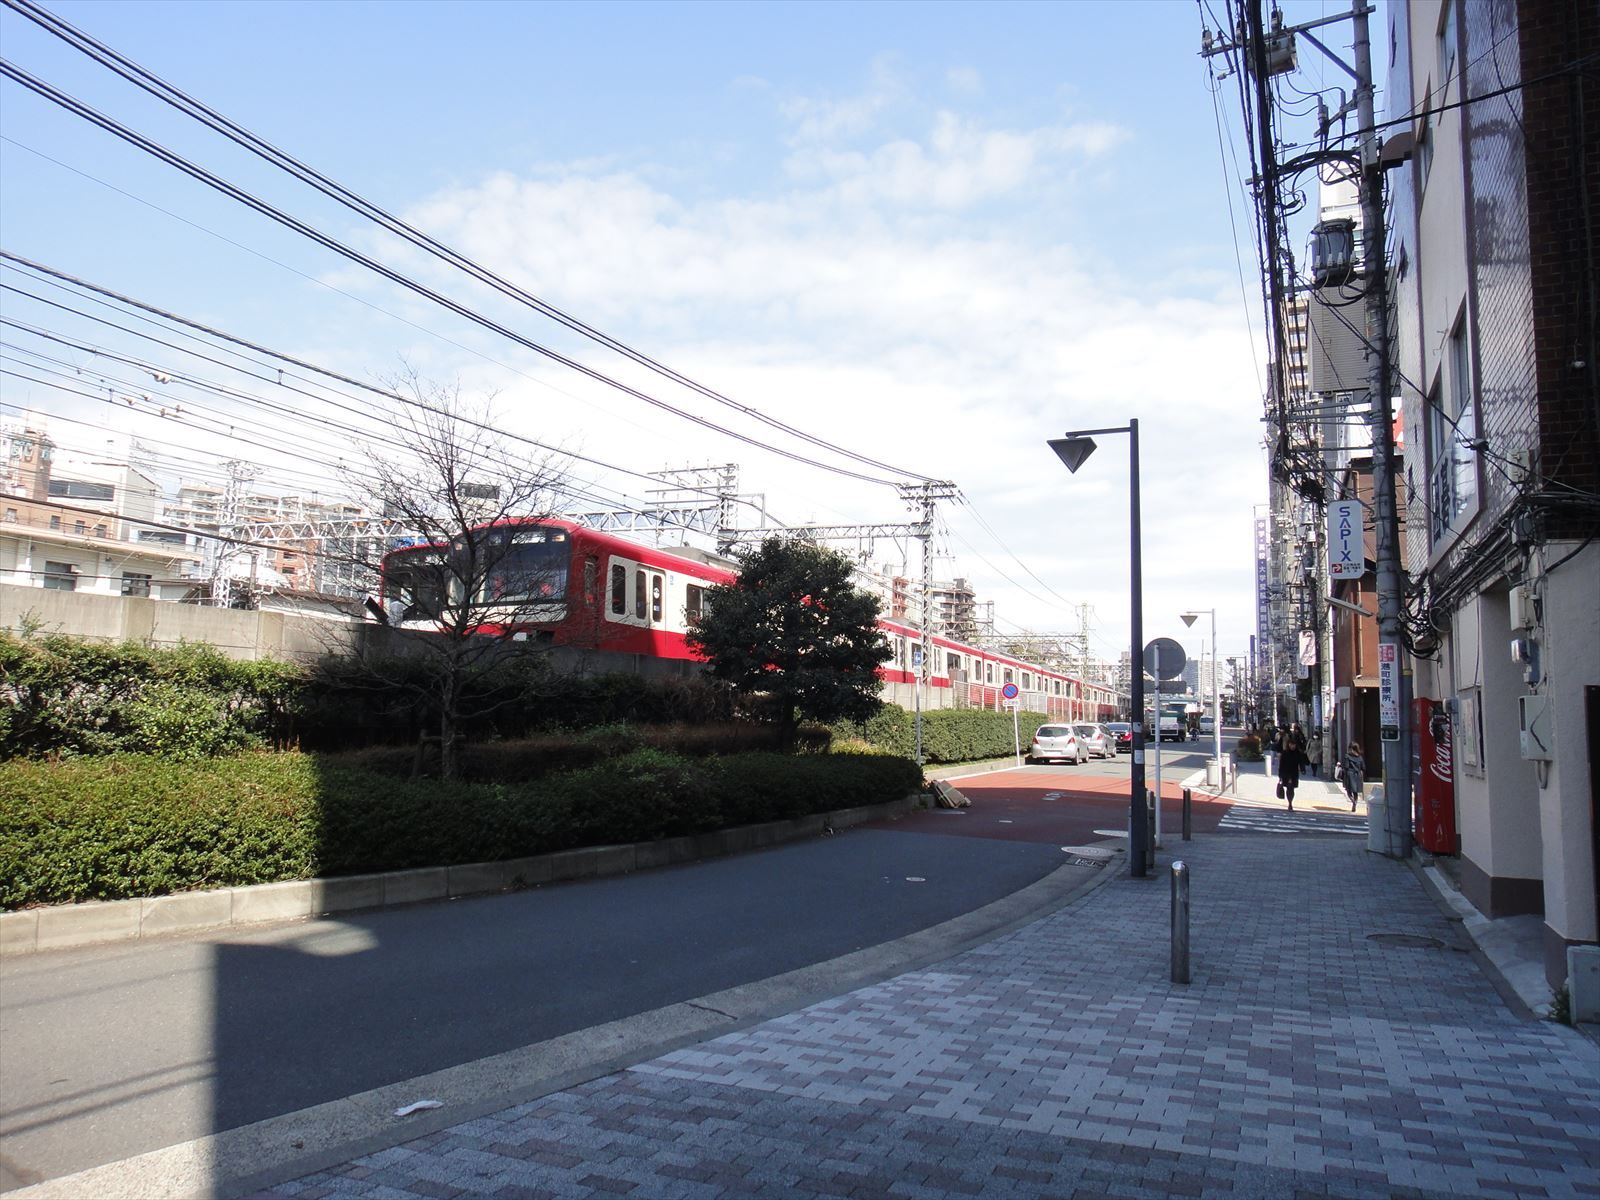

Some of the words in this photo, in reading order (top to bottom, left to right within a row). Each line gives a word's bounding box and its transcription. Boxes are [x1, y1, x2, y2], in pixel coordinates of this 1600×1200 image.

[1339, 506, 1352, 562] SAPIX
[1381, 663, 1392, 702] 港町診療所
